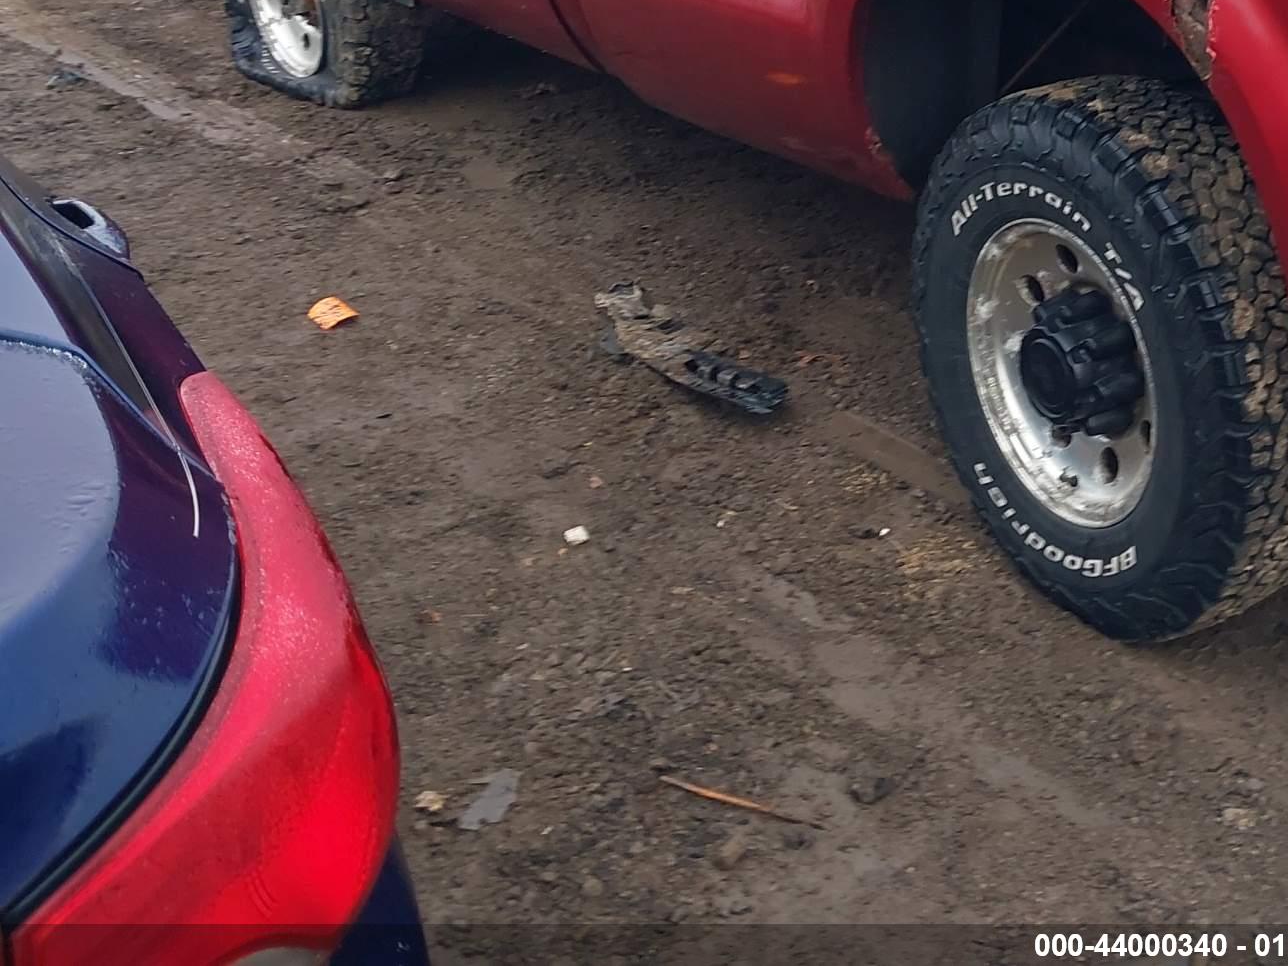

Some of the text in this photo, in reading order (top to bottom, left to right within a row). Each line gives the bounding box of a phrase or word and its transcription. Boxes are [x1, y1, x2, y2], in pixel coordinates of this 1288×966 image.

[950, 181, 1146, 313] All-Terrain T/A
[973, 462, 1139, 579] BFGoodrich
